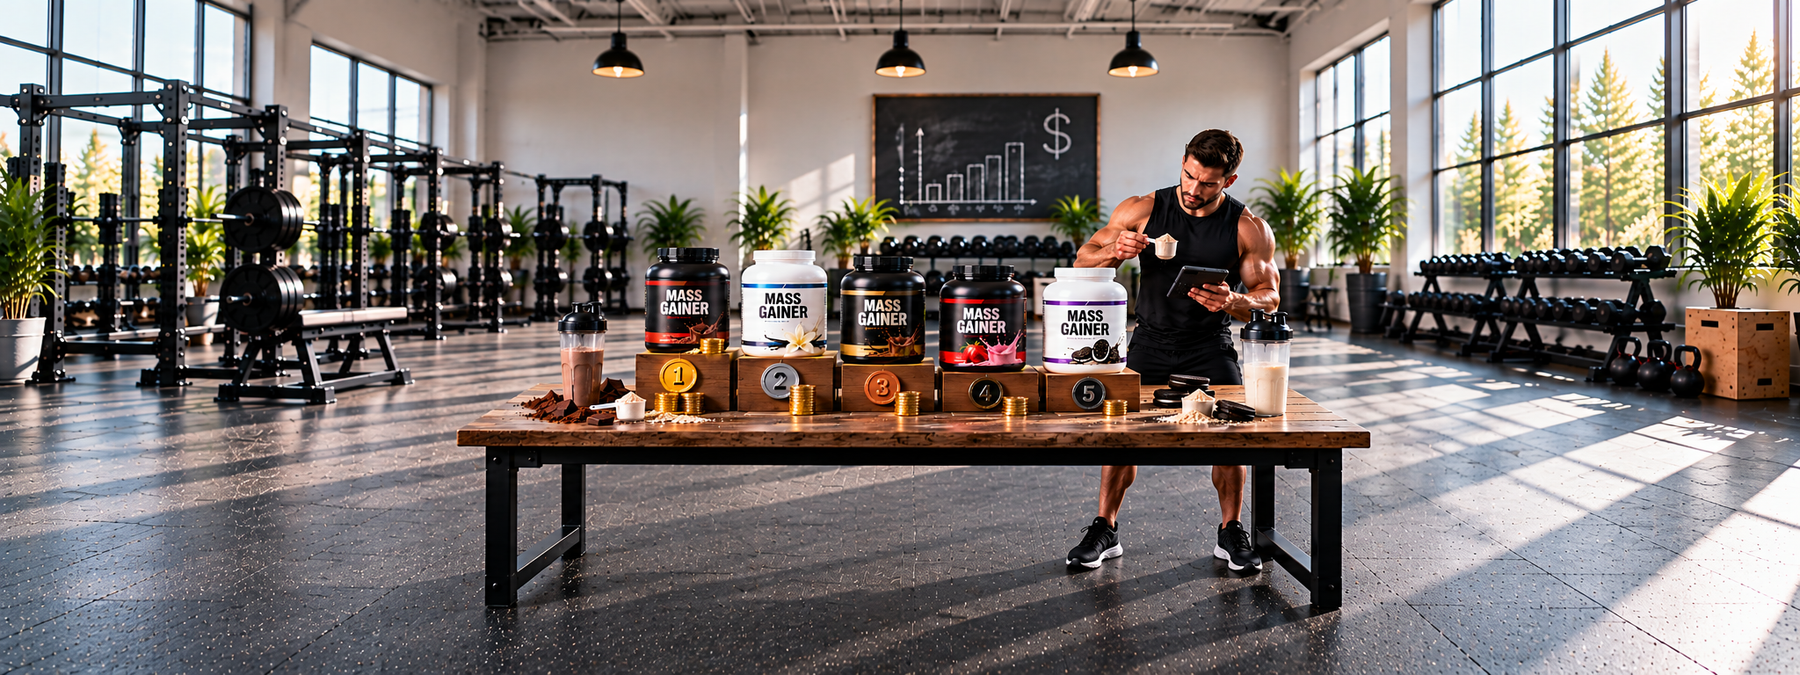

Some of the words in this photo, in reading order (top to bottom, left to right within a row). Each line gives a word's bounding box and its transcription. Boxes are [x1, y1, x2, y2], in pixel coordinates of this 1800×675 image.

[1043, 107, 1072, 160] $
[666, 289, 702, 301] MASS
[765, 293, 801, 305] MASS
[660, 301, 709, 315] GAINER
[759, 306, 808, 318] GAINER
[864, 299, 901, 312] MASS
[858, 312, 907, 326] GAINER
[963, 307, 1000, 320] MASS
[1067, 310, 1103, 322] MASS
[957, 320, 1006, 334] GAINER
[1061, 323, 1109, 336] GAINER
[673, 366, 685, 385] 1
[773, 372, 787, 390] 2
[876, 378, 889, 396] 3
[978, 384, 992, 401] 4
[1082, 385, 1095, 402] 5
